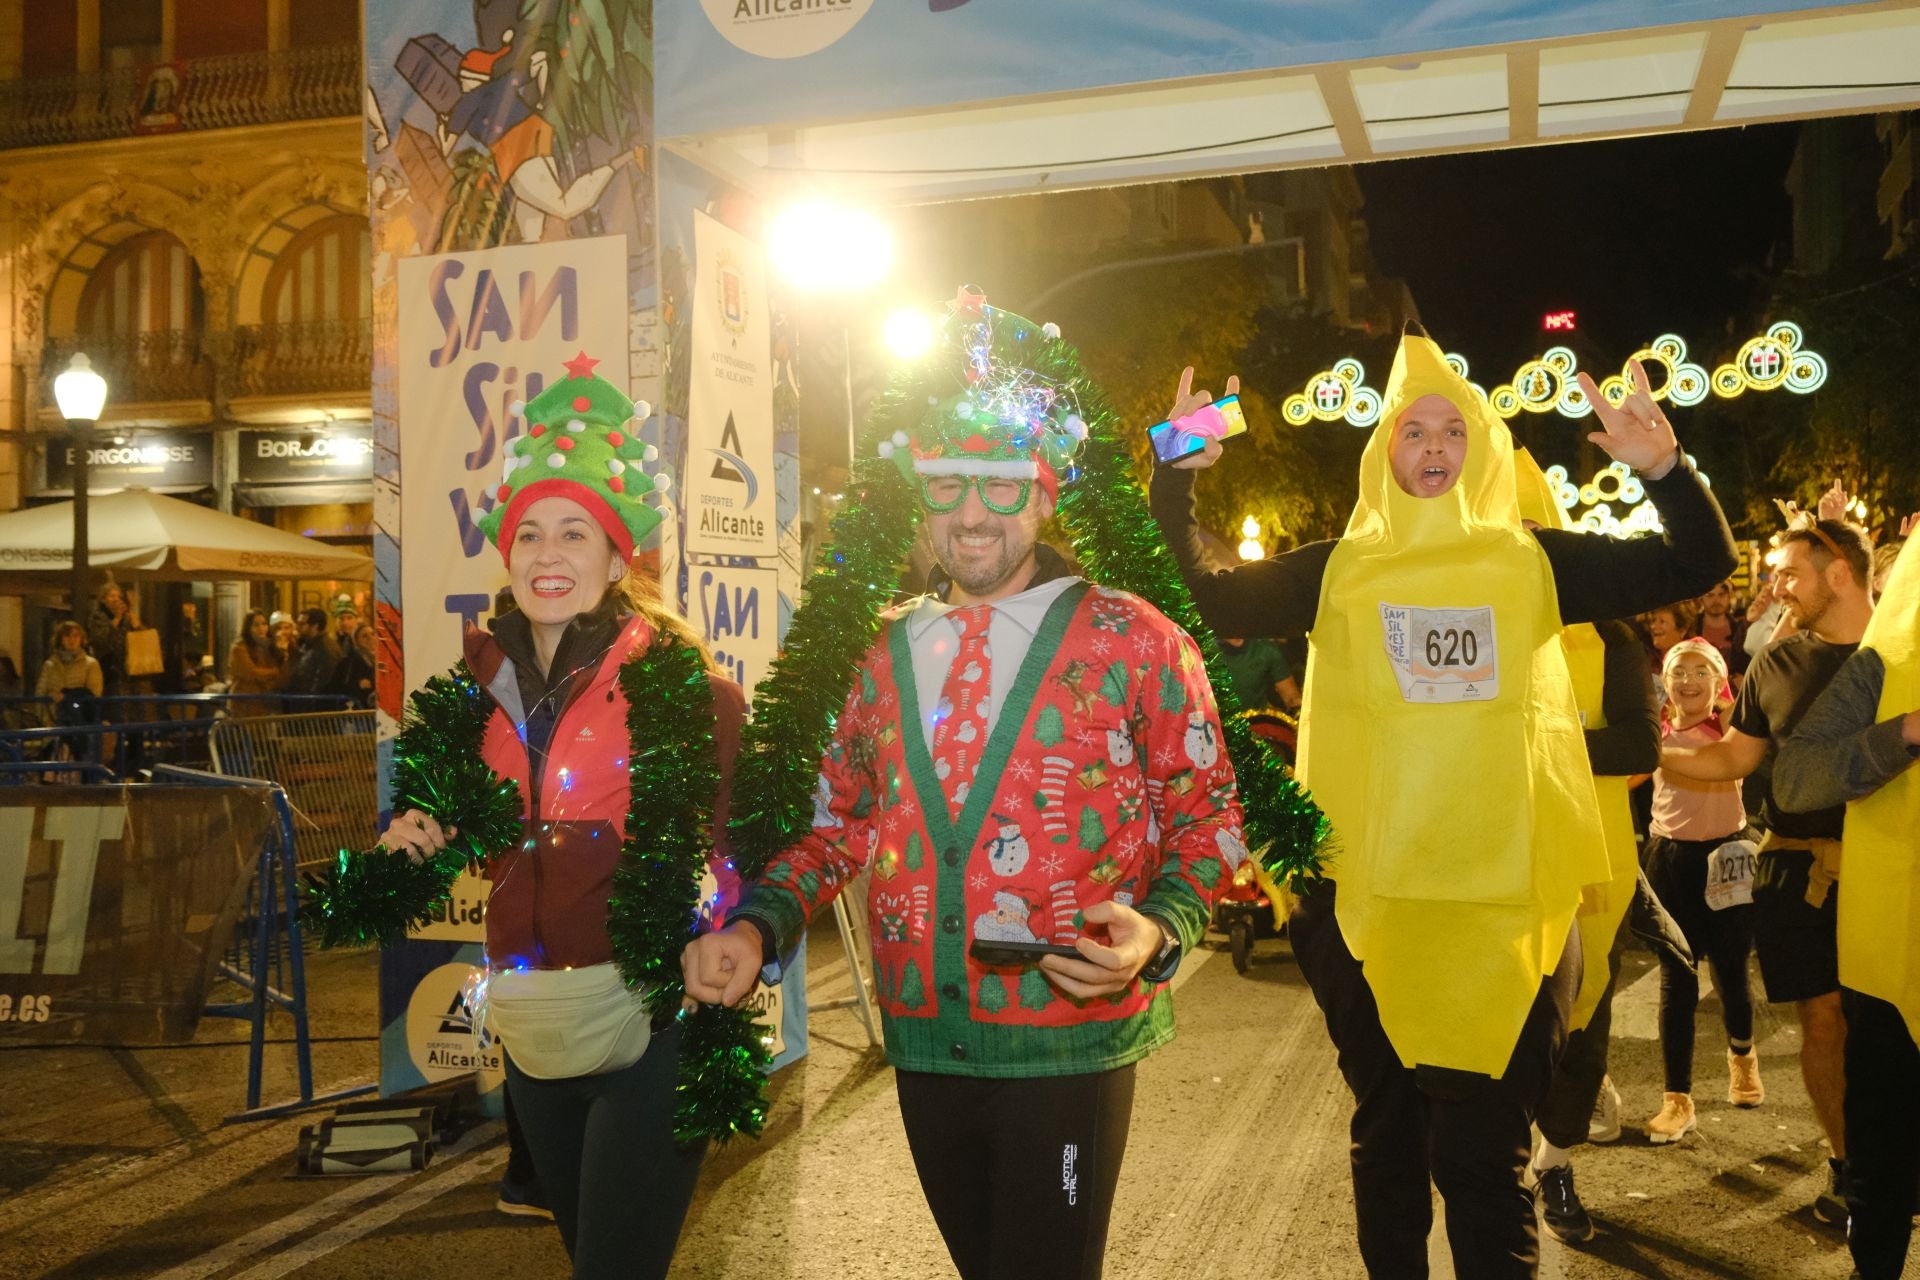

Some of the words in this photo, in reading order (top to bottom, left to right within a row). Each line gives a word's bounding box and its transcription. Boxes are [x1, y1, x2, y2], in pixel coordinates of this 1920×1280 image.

[429, 259, 579, 369] SAN
[66, 446, 194, 465] BORGONSSE
[700, 508, 764, 537] Alicante
[699, 571, 758, 645] SAN
[1384, 607, 1405, 620] SAN
[1426, 628, 1477, 666] 620
[1063, 1144, 1071, 1190] MOTION
